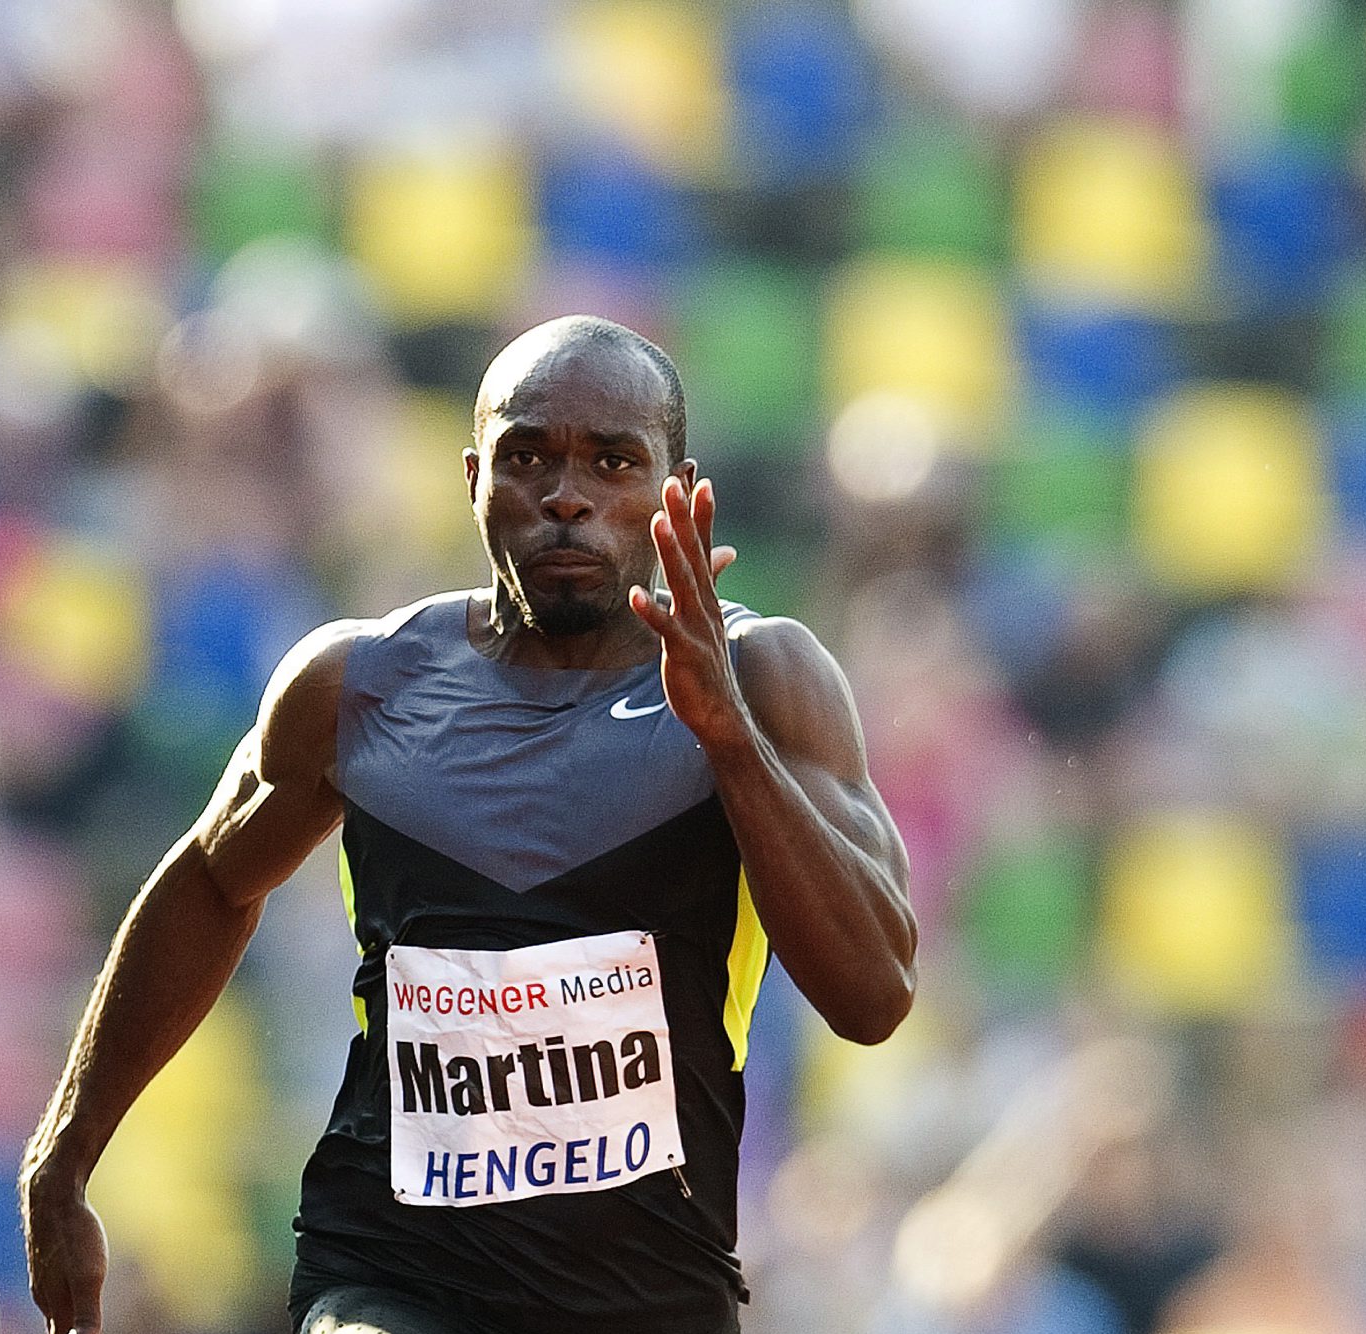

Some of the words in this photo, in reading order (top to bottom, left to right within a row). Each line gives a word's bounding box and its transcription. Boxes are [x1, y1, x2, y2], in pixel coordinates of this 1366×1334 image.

[560, 965, 653, 1005] Media
[396, 1030, 662, 1117] Martina
[422, 1122, 651, 1199] HENGELO
